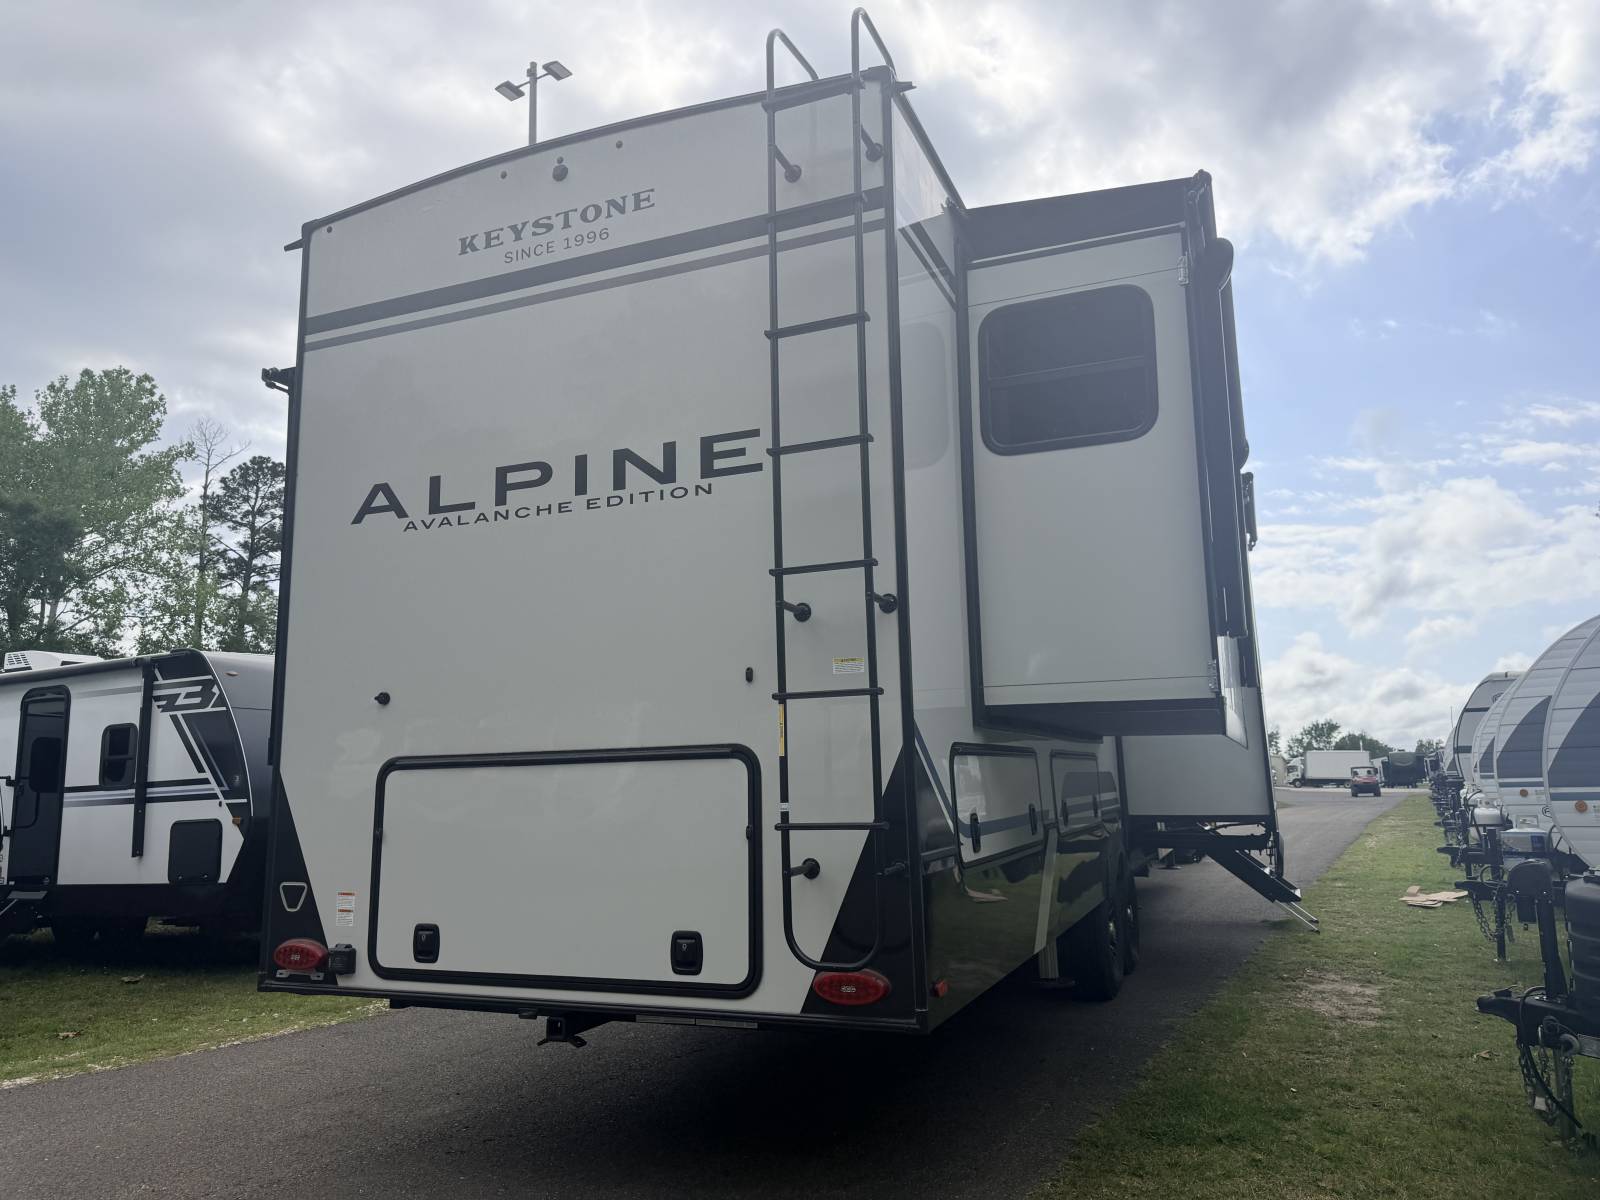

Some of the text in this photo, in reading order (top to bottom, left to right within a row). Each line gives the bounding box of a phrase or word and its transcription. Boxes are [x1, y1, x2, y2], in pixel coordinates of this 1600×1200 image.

[458, 188, 655, 255] KEYSTONE
[503, 227, 610, 264] SINCE 1996
[350, 428, 763, 525] ALPINE
[403, 483, 713, 532] AVALANCHE EDITION
